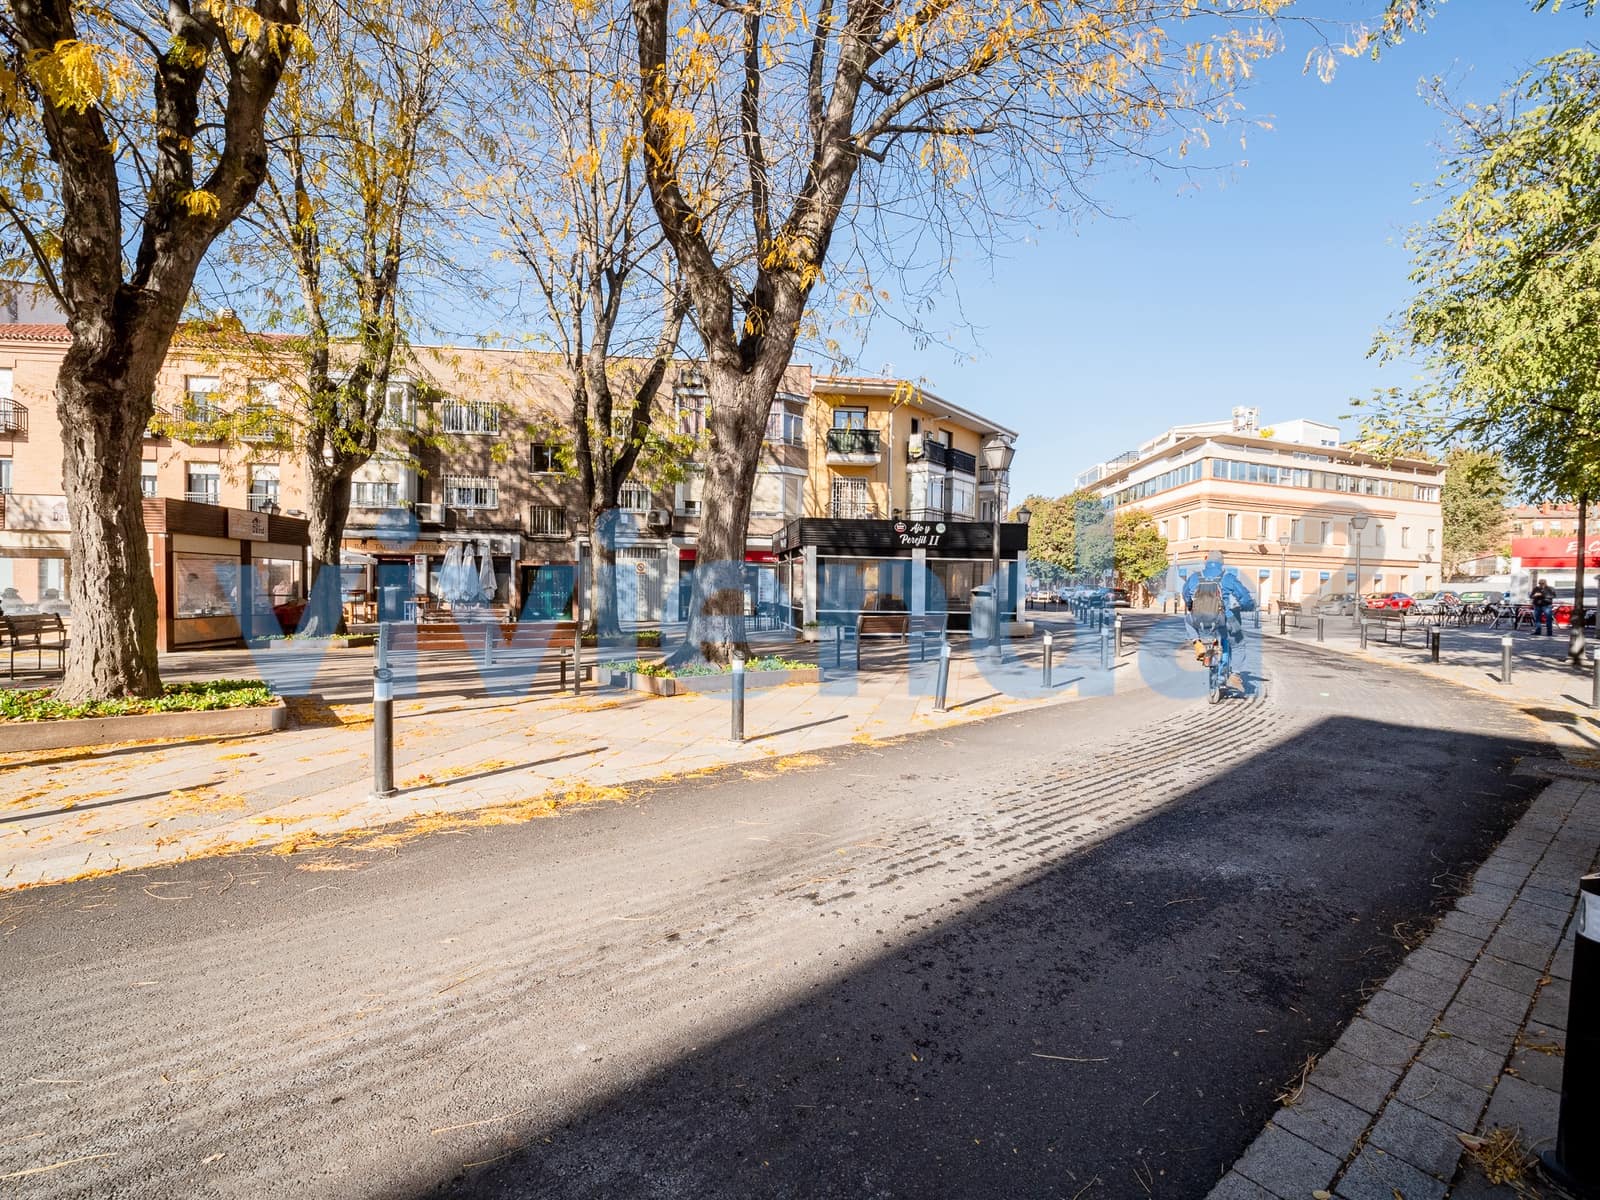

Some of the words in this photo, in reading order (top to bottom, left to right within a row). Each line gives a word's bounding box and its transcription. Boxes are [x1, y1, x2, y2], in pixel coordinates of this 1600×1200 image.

[910, 522, 924, 534] Ajo
[925, 525, 931, 534] y
[900, 533, 927, 547] Perejil
